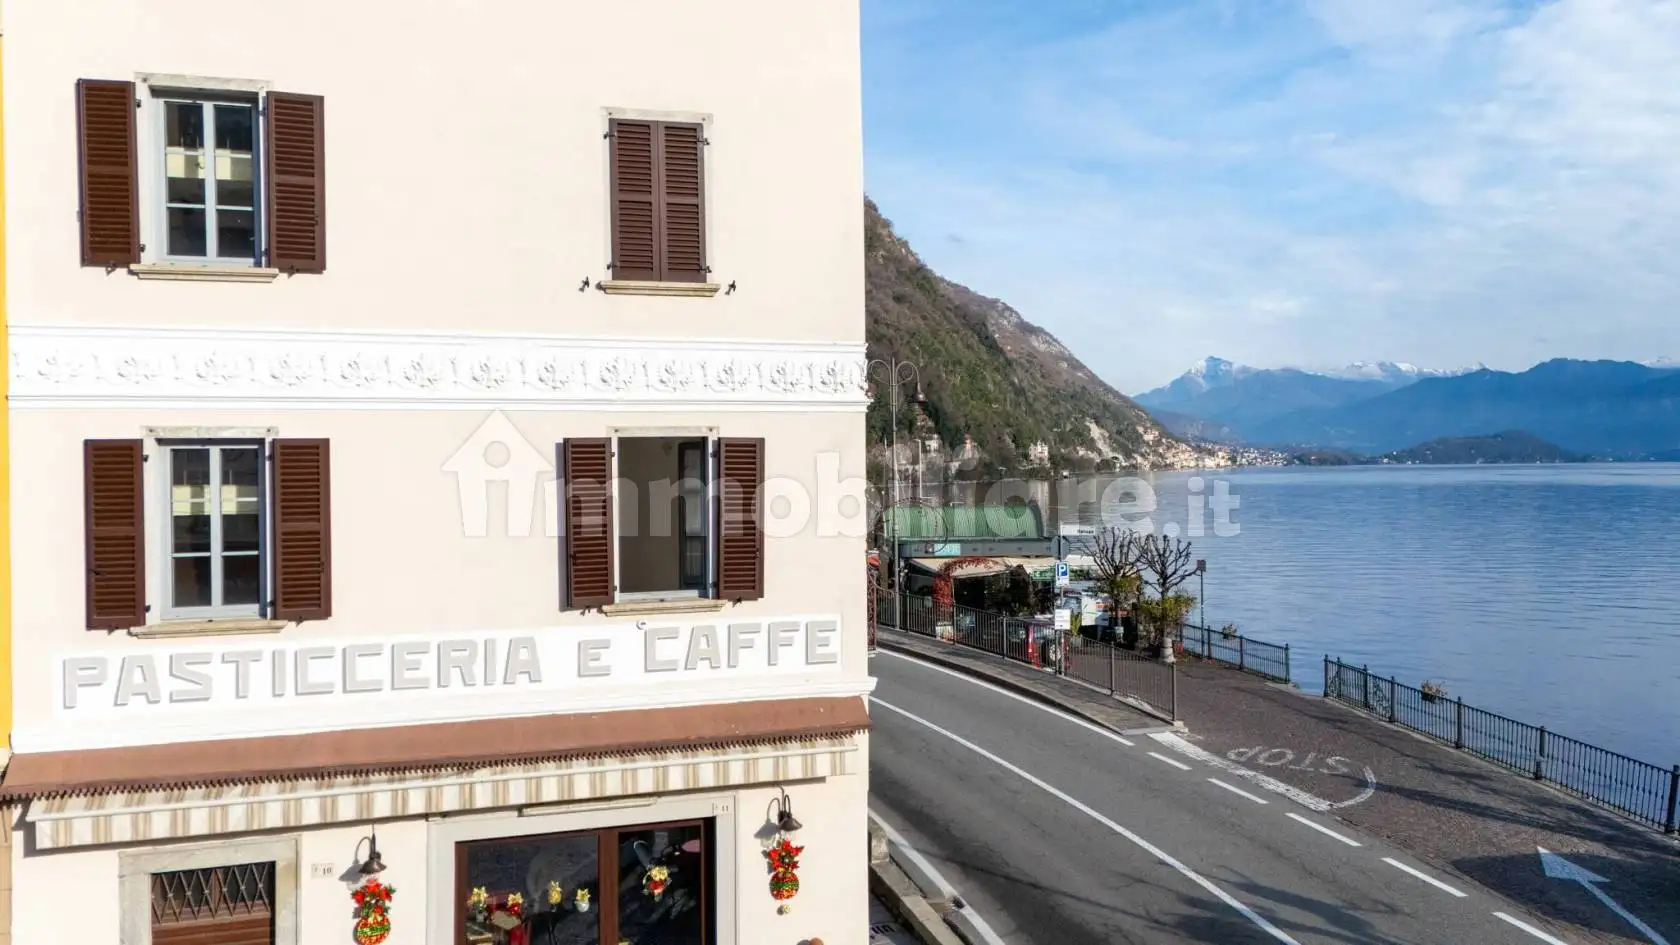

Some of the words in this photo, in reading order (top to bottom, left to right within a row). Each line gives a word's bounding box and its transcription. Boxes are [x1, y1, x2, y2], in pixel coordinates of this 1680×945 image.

[1059, 564, 1067, 577] P
[63, 636, 543, 709] PASTICCERIA
[577, 639, 612, 678] E
[643, 620, 838, 674] CAFFE
[1226, 746, 1351, 775] STOP
